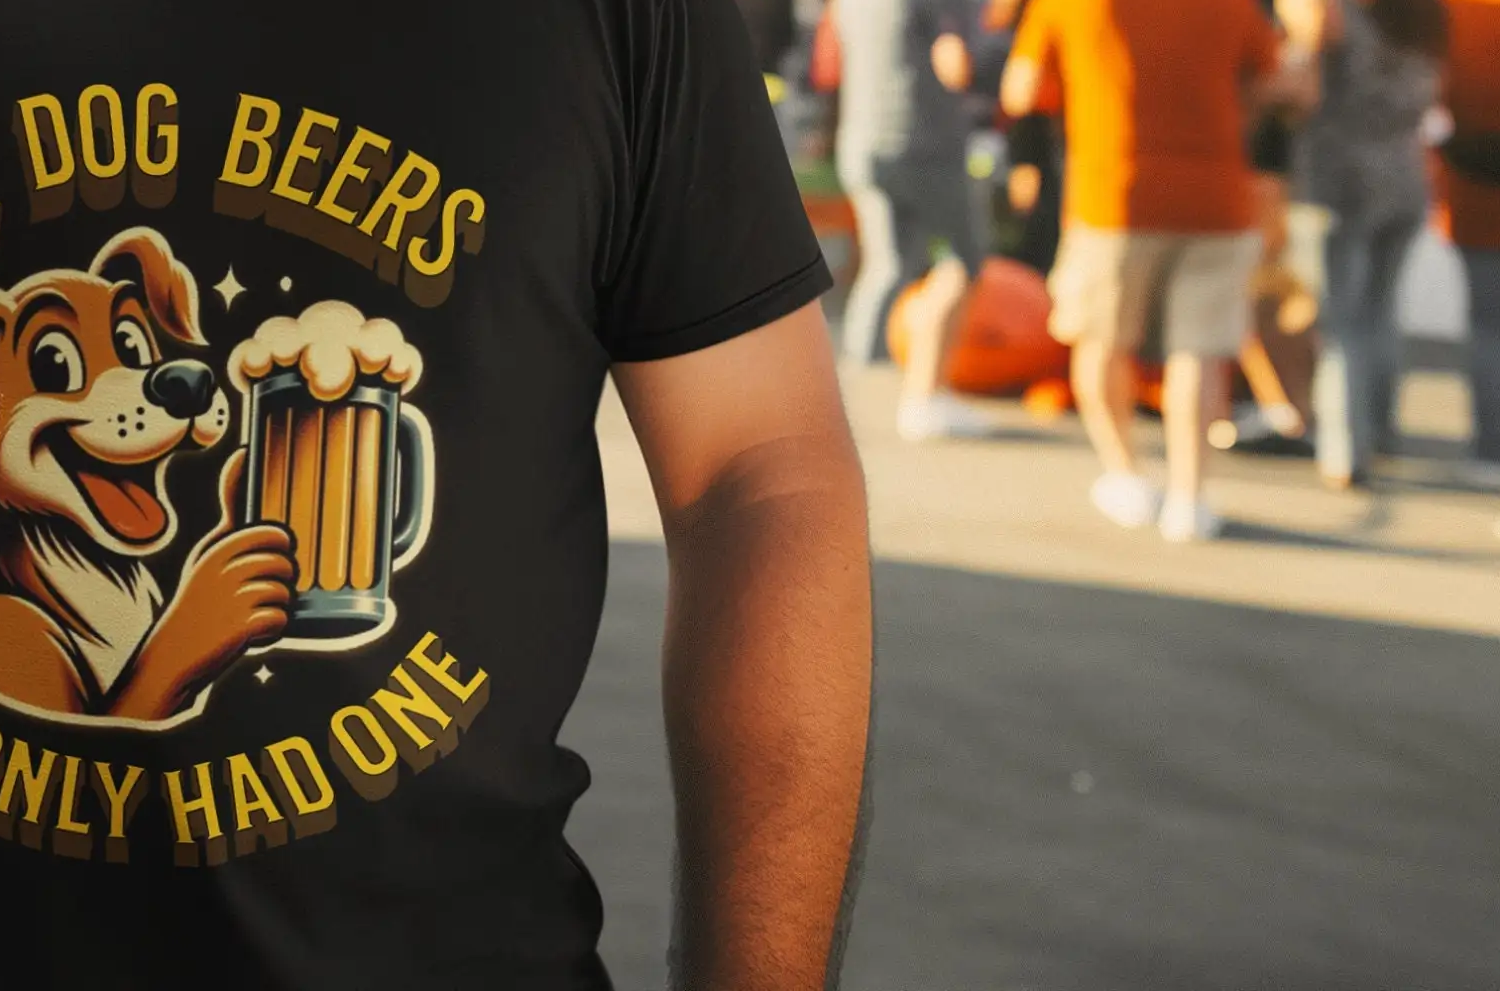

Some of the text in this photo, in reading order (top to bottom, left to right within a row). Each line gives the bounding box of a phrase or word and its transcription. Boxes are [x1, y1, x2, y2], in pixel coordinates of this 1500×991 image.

[17, 83, 179, 191] DOG
[218, 92, 485, 276] BEERS
[163, 735, 335, 844] HAD
[329, 631, 489, 777] ONE
